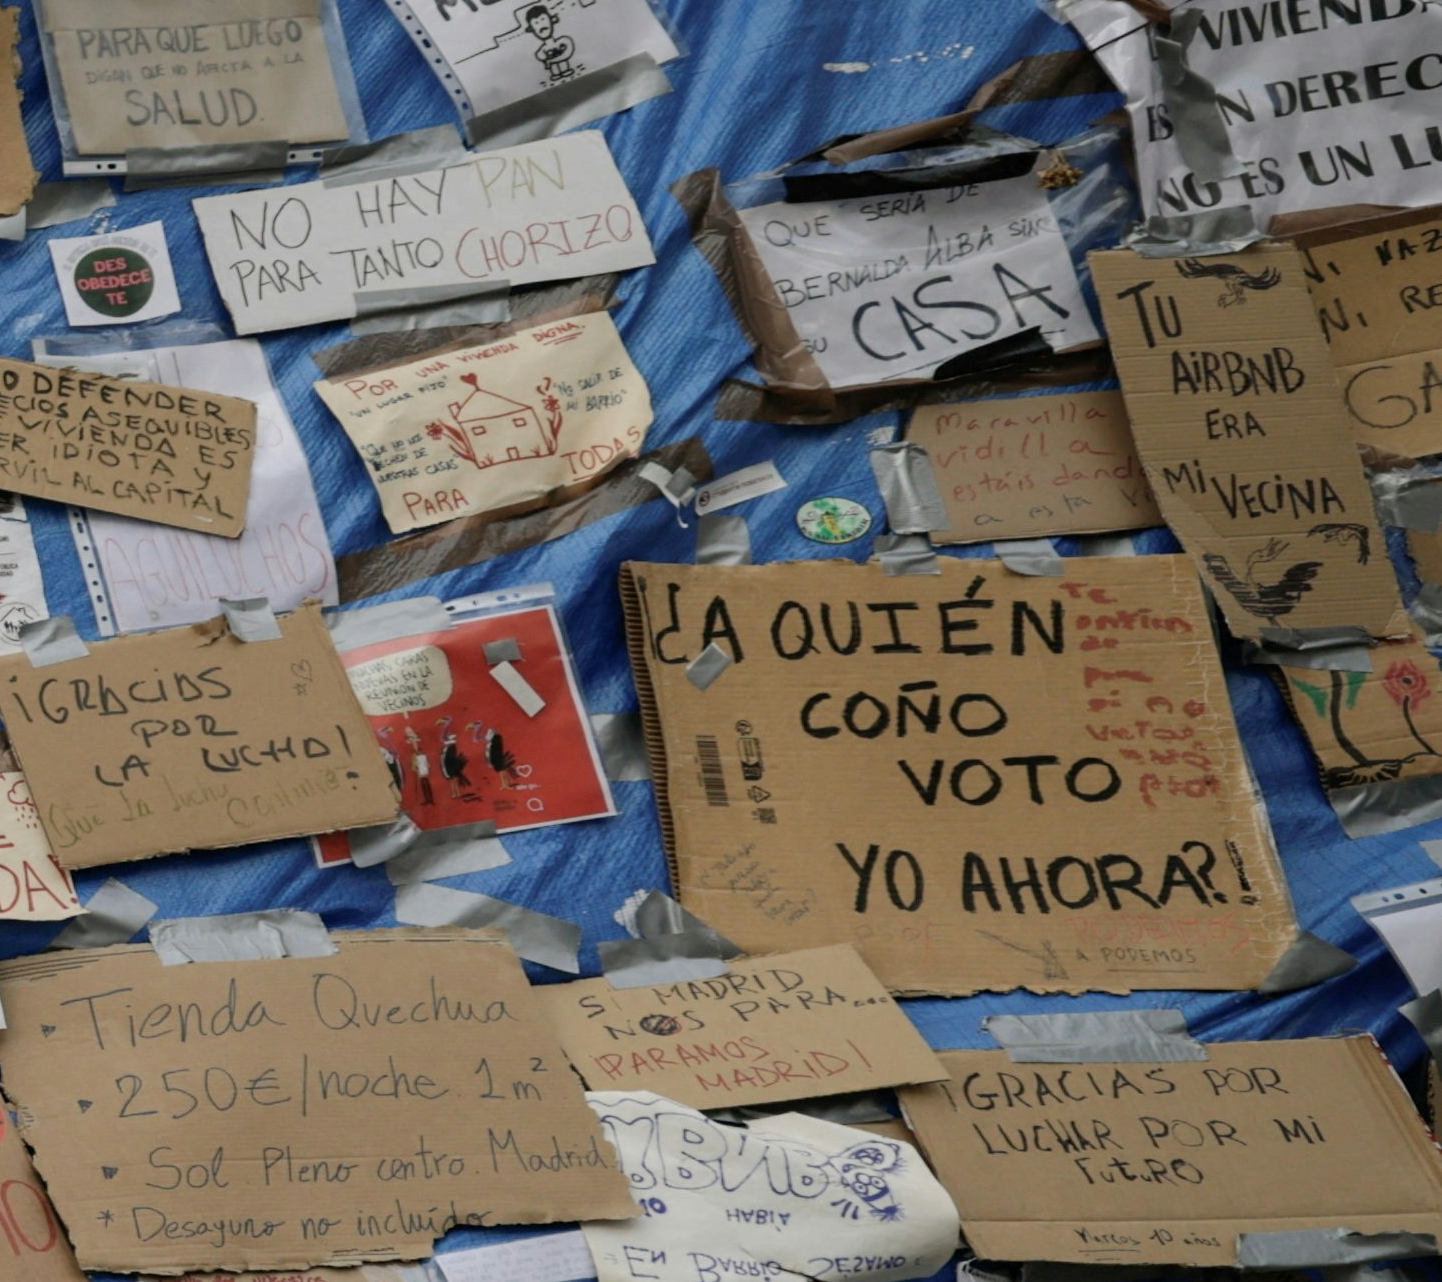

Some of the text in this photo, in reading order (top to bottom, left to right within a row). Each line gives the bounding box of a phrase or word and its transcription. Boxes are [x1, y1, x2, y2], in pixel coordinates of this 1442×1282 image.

[76, 19, 303, 60] PARA QUE LUEGO
[1299, 141, 1374, 187] UN
[229, 197, 313, 254] NO
[355, 167, 449, 229] HAY
[471, 151, 565, 212] PAN
[762, 215, 832, 249] QUE
[93, 257, 127, 273] DES
[229, 204, 635, 308] PARA TANTO CHORIZO
[77, 269, 151, 290] OBEDECE
[105, 291, 128, 305] TE
[775, 251, 911, 308] BERNALDA
[851, 261, 1072, 364] CASA
[1115, 280, 1184, 350] TU
[33, 370, 227, 424] DEFENDER
[1206, 406, 1268, 441] ERA
[560, 425, 643, 476] TODAS
[73, 472, 105, 496] AL
[769, 574, 1067, 662] QUIÉN
[130, 713, 240, 749] POR
[799, 679, 1009, 739] COÑO
[93, 755, 153, 788] LA
[896, 755, 1123, 807] VOTO
[833, 842, 926, 915] YO
[1099, 943, 1199, 968] PODEMOS
[60, 972, 521, 1051] Tienda Quechua
[1202, 1066, 1289, 1096] POR
[972, 1116, 1247, 1156] LUCHAR POR
[144, 1144, 362, 1192] Sol Pleno
[1183, 1234, 1222, 1247] años
